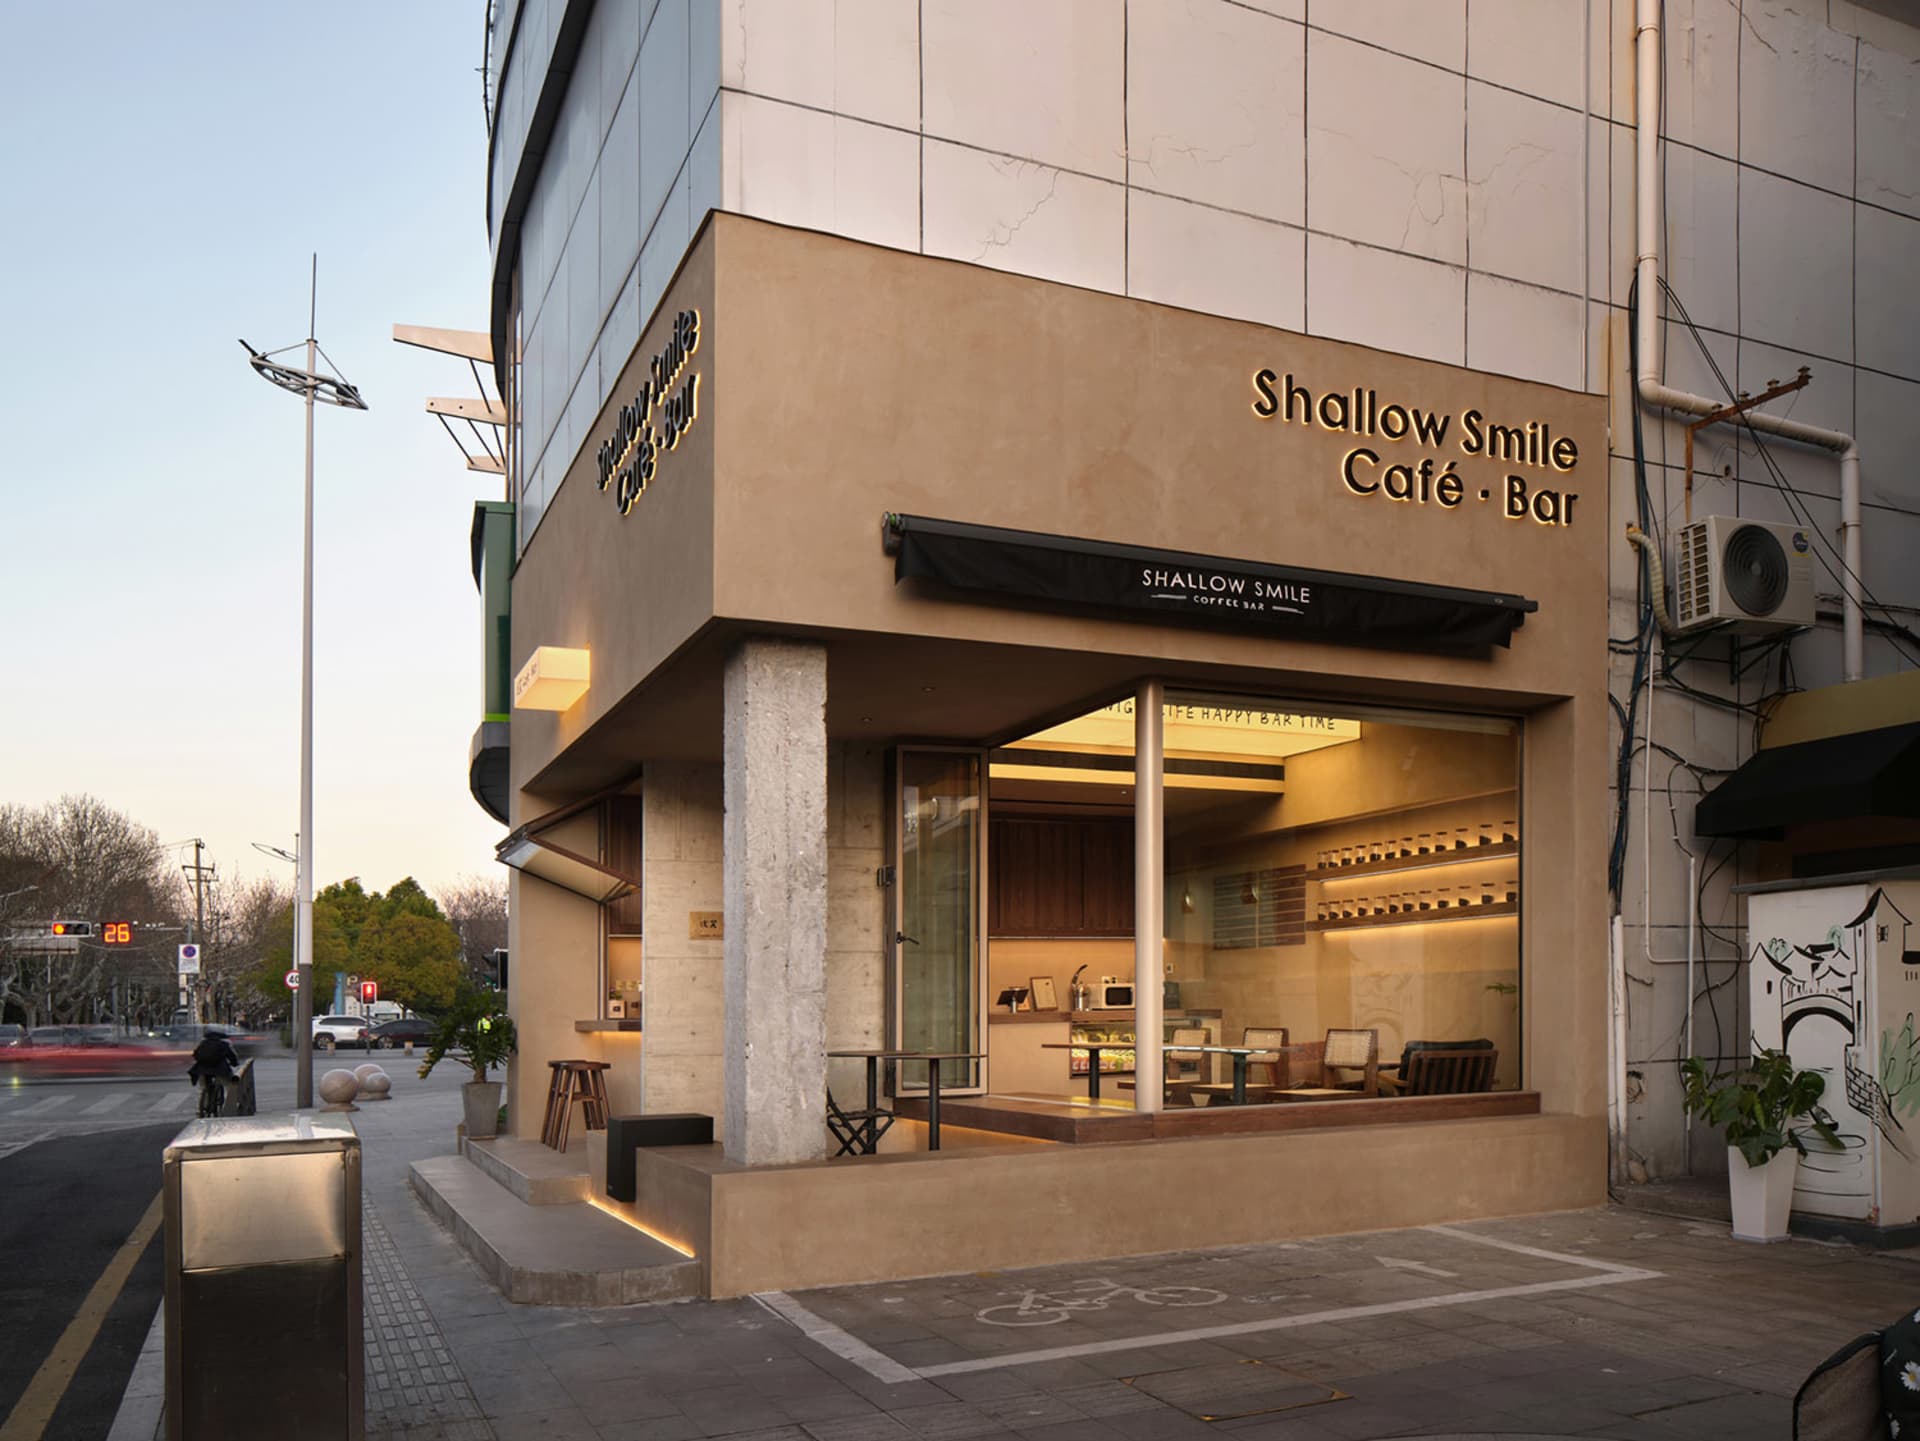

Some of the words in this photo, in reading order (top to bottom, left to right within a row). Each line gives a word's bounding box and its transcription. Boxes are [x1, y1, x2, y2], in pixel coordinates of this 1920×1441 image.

[1252, 368, 1450, 448] Shallow
[1460, 409, 1578, 471] Smile
[1342, 447, 1464, 509] Café
[1504, 474, 1579, 526] Bar
[1142, 569, 1245, 595] SHALLOW
[1254, 581, 1310, 604] SMILE
[1193, 594, 1239, 608] COFFEE
[1243, 601, 1265, 611] BAR
[1201, 707, 1252, 725] HAPPY
[1260, 712, 1292, 727] BAR
[1300, 715, 1336, 731] TIME
[104, 923, 130, 943] 26
